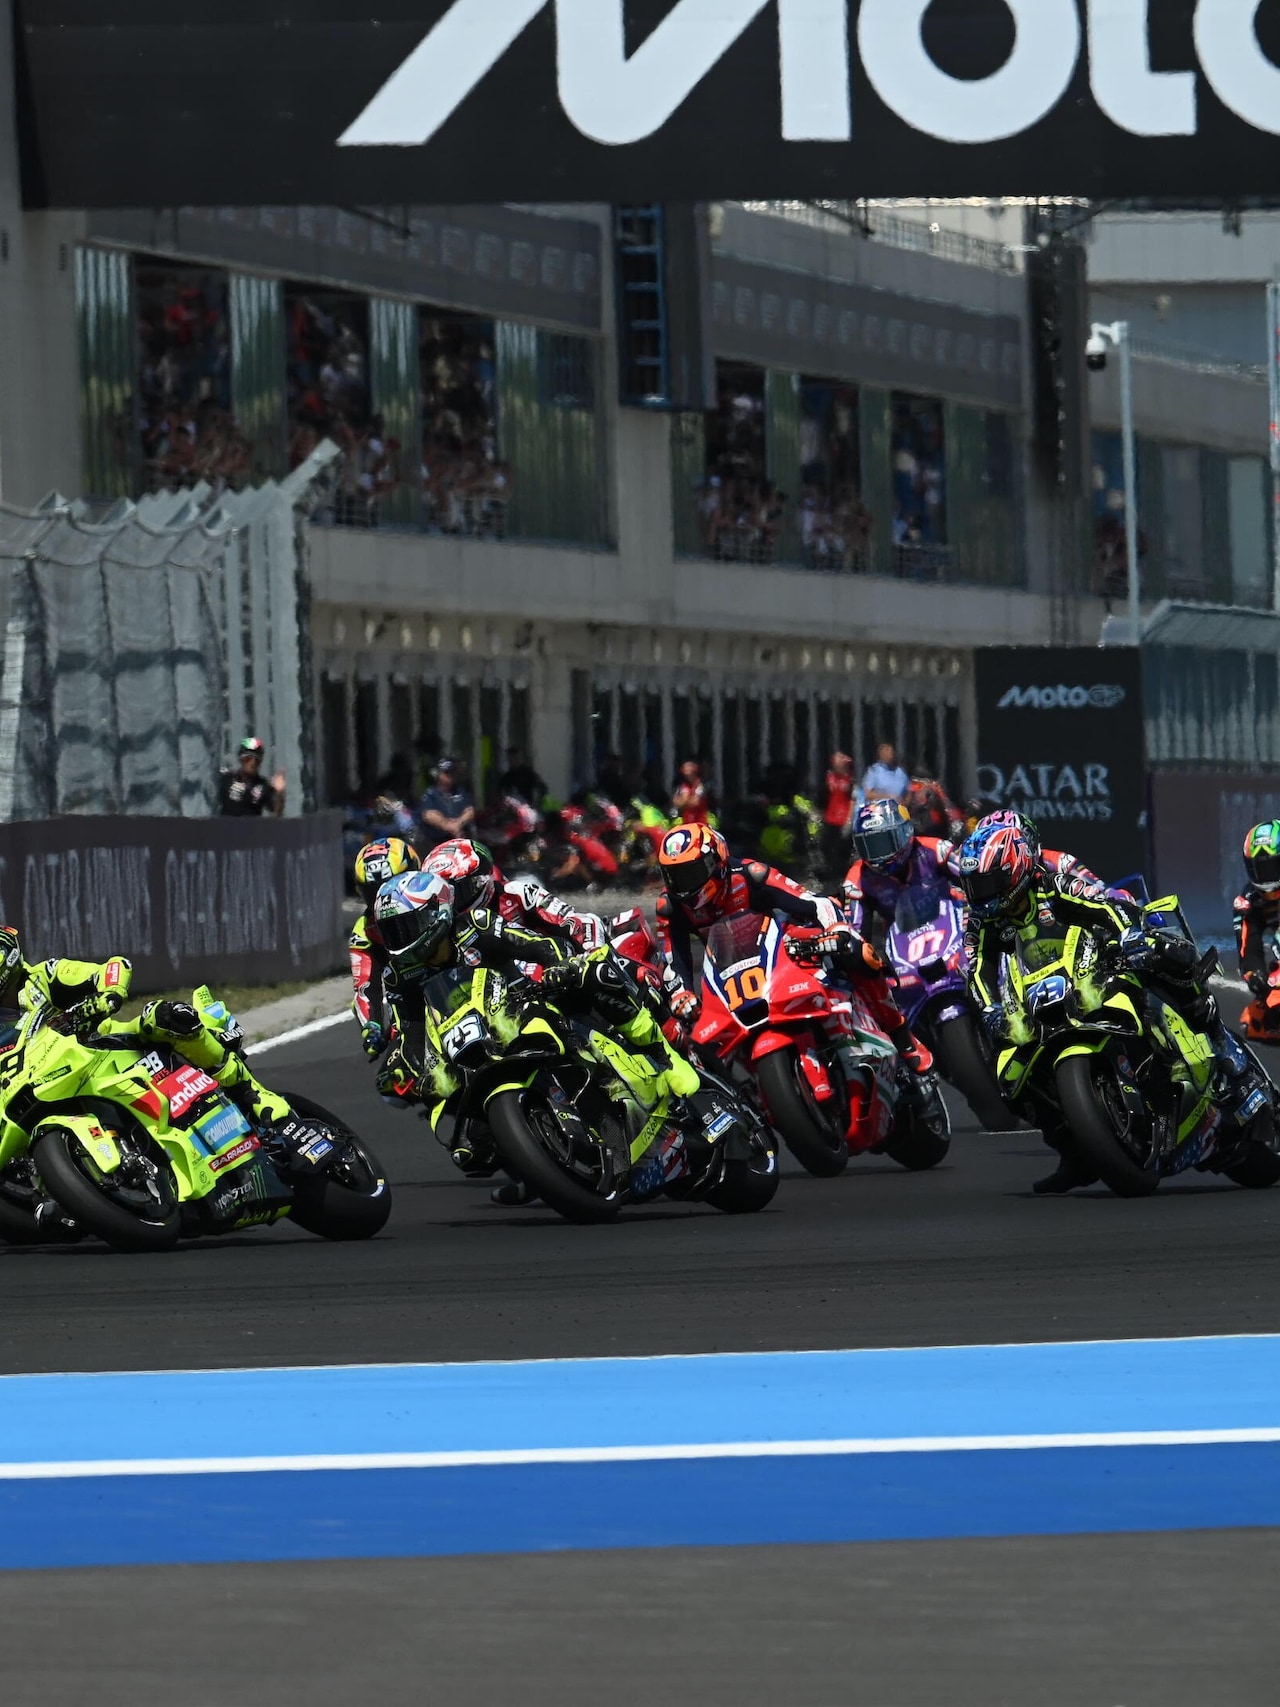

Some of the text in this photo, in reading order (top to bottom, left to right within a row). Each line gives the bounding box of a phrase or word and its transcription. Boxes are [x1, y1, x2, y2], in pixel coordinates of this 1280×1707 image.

[976, 763, 1111, 803] QATAR
[728, 957, 759, 975] Castrol
[723, 966, 767, 1012] 10
[788, 981, 810, 994] IBM
[699, 1020, 719, 1039] IBM
